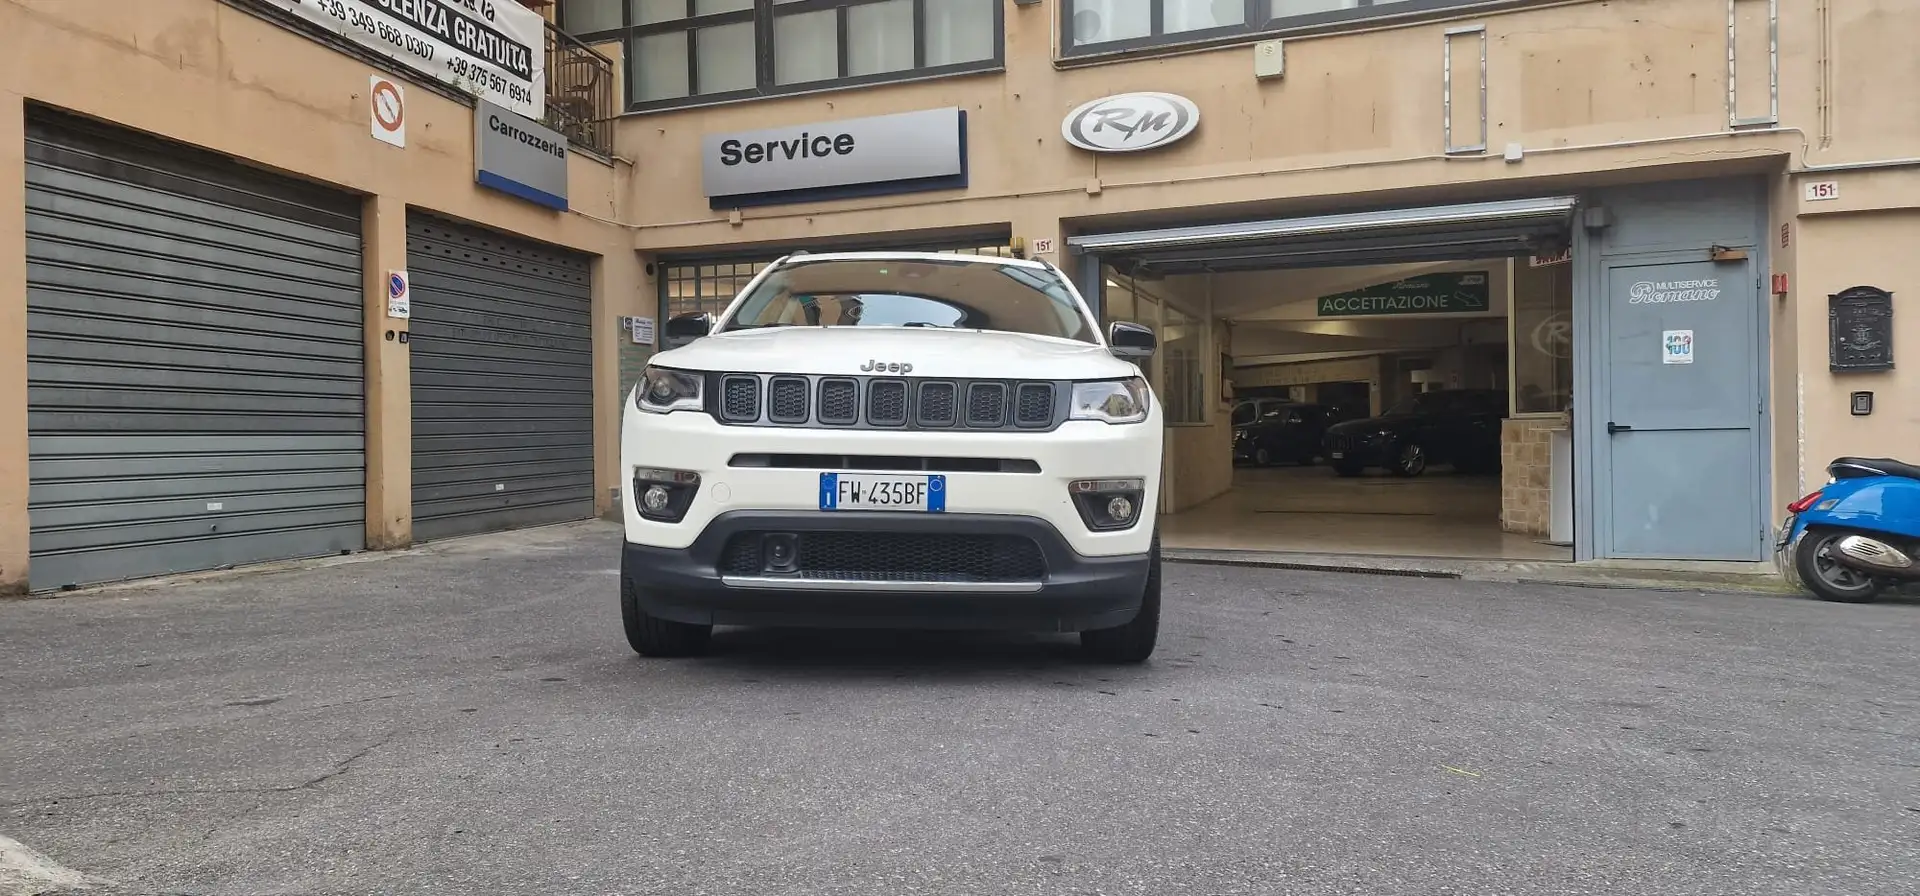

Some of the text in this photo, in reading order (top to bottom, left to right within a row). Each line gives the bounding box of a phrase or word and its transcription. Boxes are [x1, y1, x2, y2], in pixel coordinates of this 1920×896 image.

[378, 0, 529, 76] LENZA GRATUITA
[317, 0, 532, 106] +39 349 668 0307 +39 375 567 6914
[489, 114, 565, 159] Carrozzeria
[720, 132, 855, 166] Service
[1812, 184, 1834, 197] 151
[1629, 281, 1720, 303] Romano
[1656, 279, 1718, 290] MULTISERVICE
[1322, 294, 1449, 312] ACCETTAZIONE
[860, 359, 914, 375] Jeep
